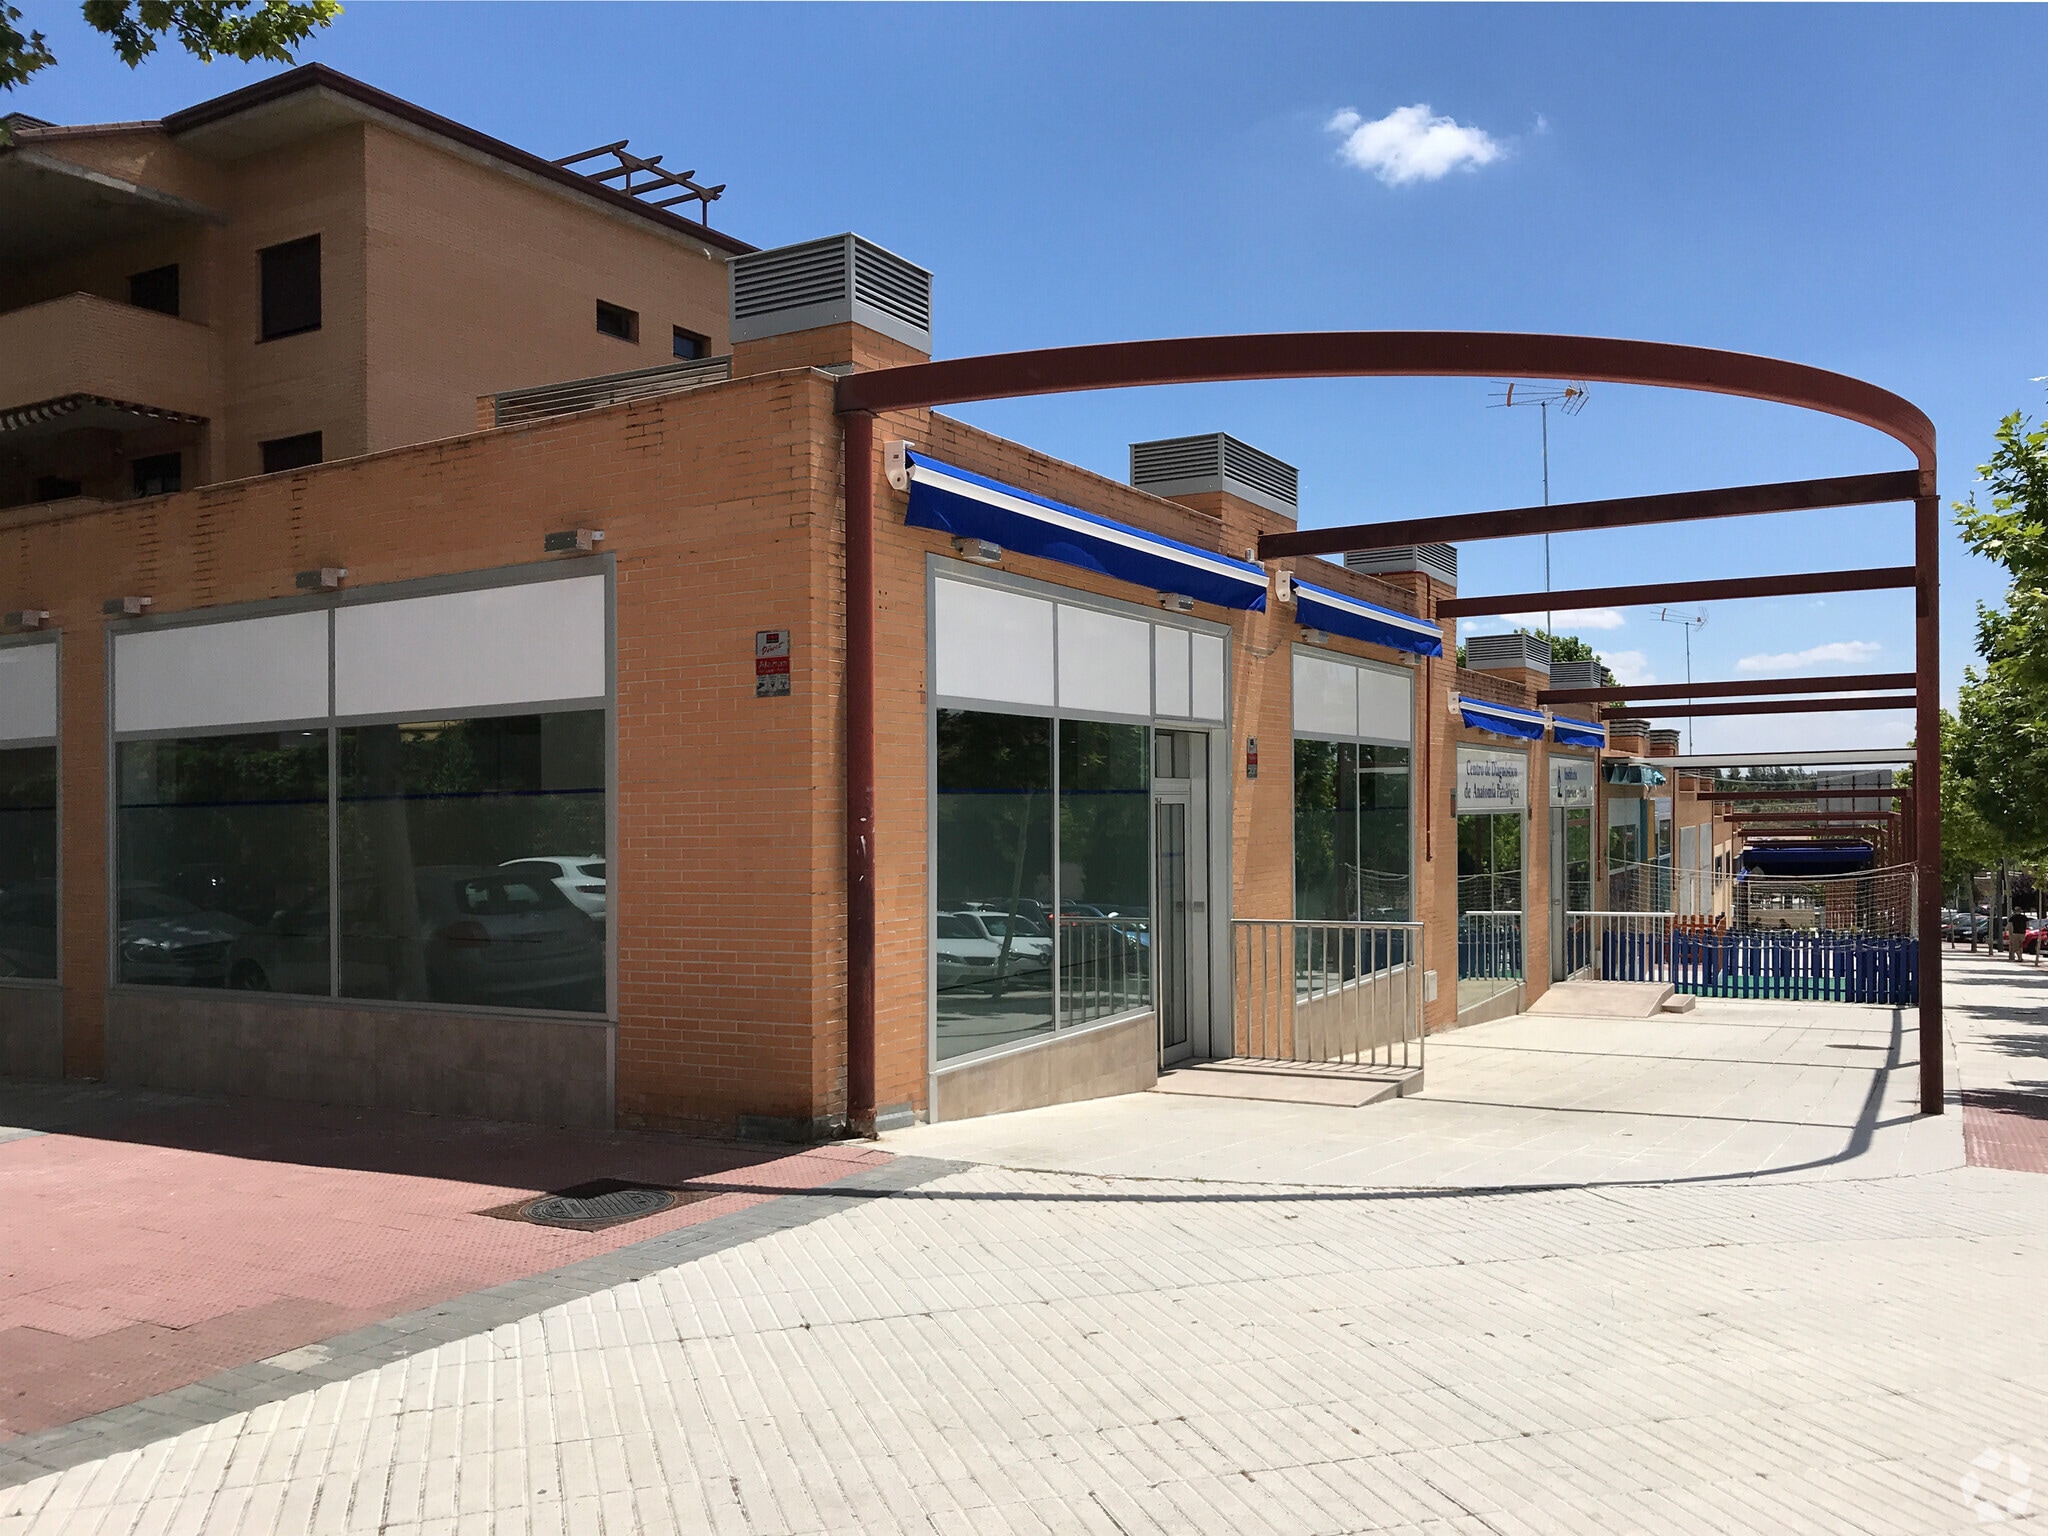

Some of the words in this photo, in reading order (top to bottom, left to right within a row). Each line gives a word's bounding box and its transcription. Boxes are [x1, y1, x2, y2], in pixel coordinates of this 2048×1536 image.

[1466, 759, 1484, 776] Centro
[1484, 760, 1491, 776] de
[1464, 782, 1471, 799] de
